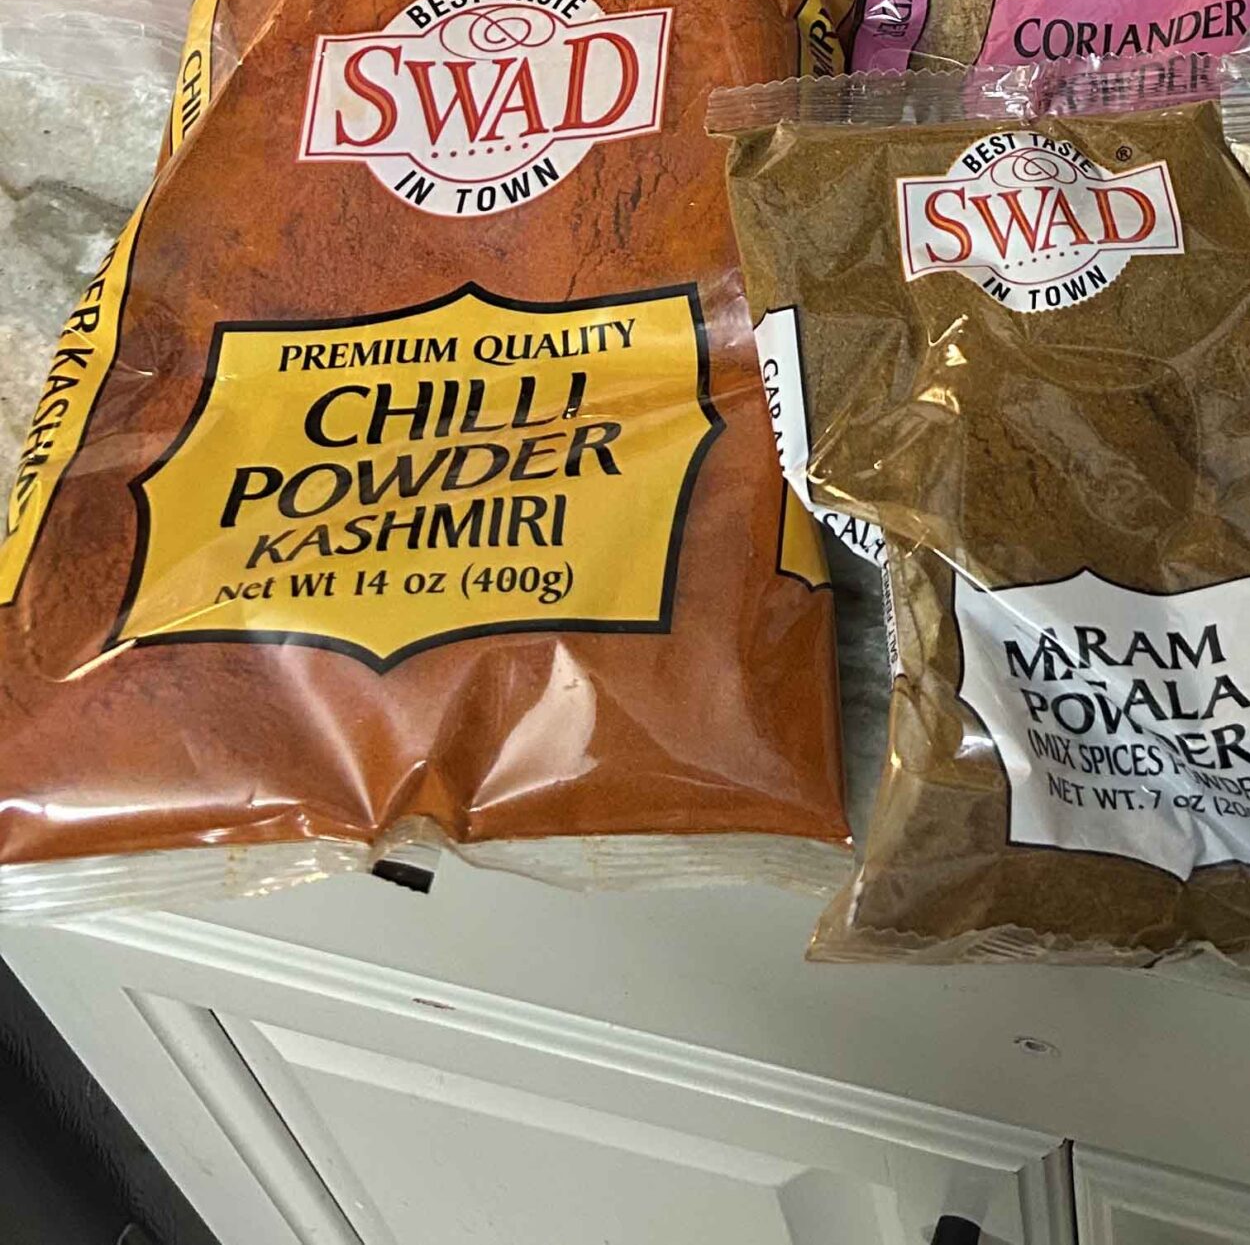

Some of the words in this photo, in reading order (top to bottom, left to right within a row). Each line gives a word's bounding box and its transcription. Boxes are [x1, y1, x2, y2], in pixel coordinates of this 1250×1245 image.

[334, 32, 640, 148] SWAD
[962, 133, 1017, 174] BEST
[1028, 133, 1096, 174] TASTE
[394, 169, 435, 207] IN
[456, 157, 560, 214] TOWN
[924, 186, 1157, 264] SWAD
[982, 276, 1012, 301] IN
[1028, 265, 1108, 310] TOWN
[278, 337, 458, 373] PREMIUM
[473, 318, 637, 364] QUALITY
[303, 371, 587, 449] CHILLI
[220, 421, 623, 529] POWDER
[245, 493, 568, 570] KASHMIRI
[214, 578, 277, 604] Net
[288, 570, 335, 598] Wt
[353, 570, 389, 597] 14
[403, 571, 447, 595] oz
[461, 561, 574, 605] (400g)
[1027, 728, 1078, 769] (MIX
[1078, 744, 1164, 777] SPICES
[1048, 771, 1085, 807] NET
[1172, 793, 1206, 813] oz
